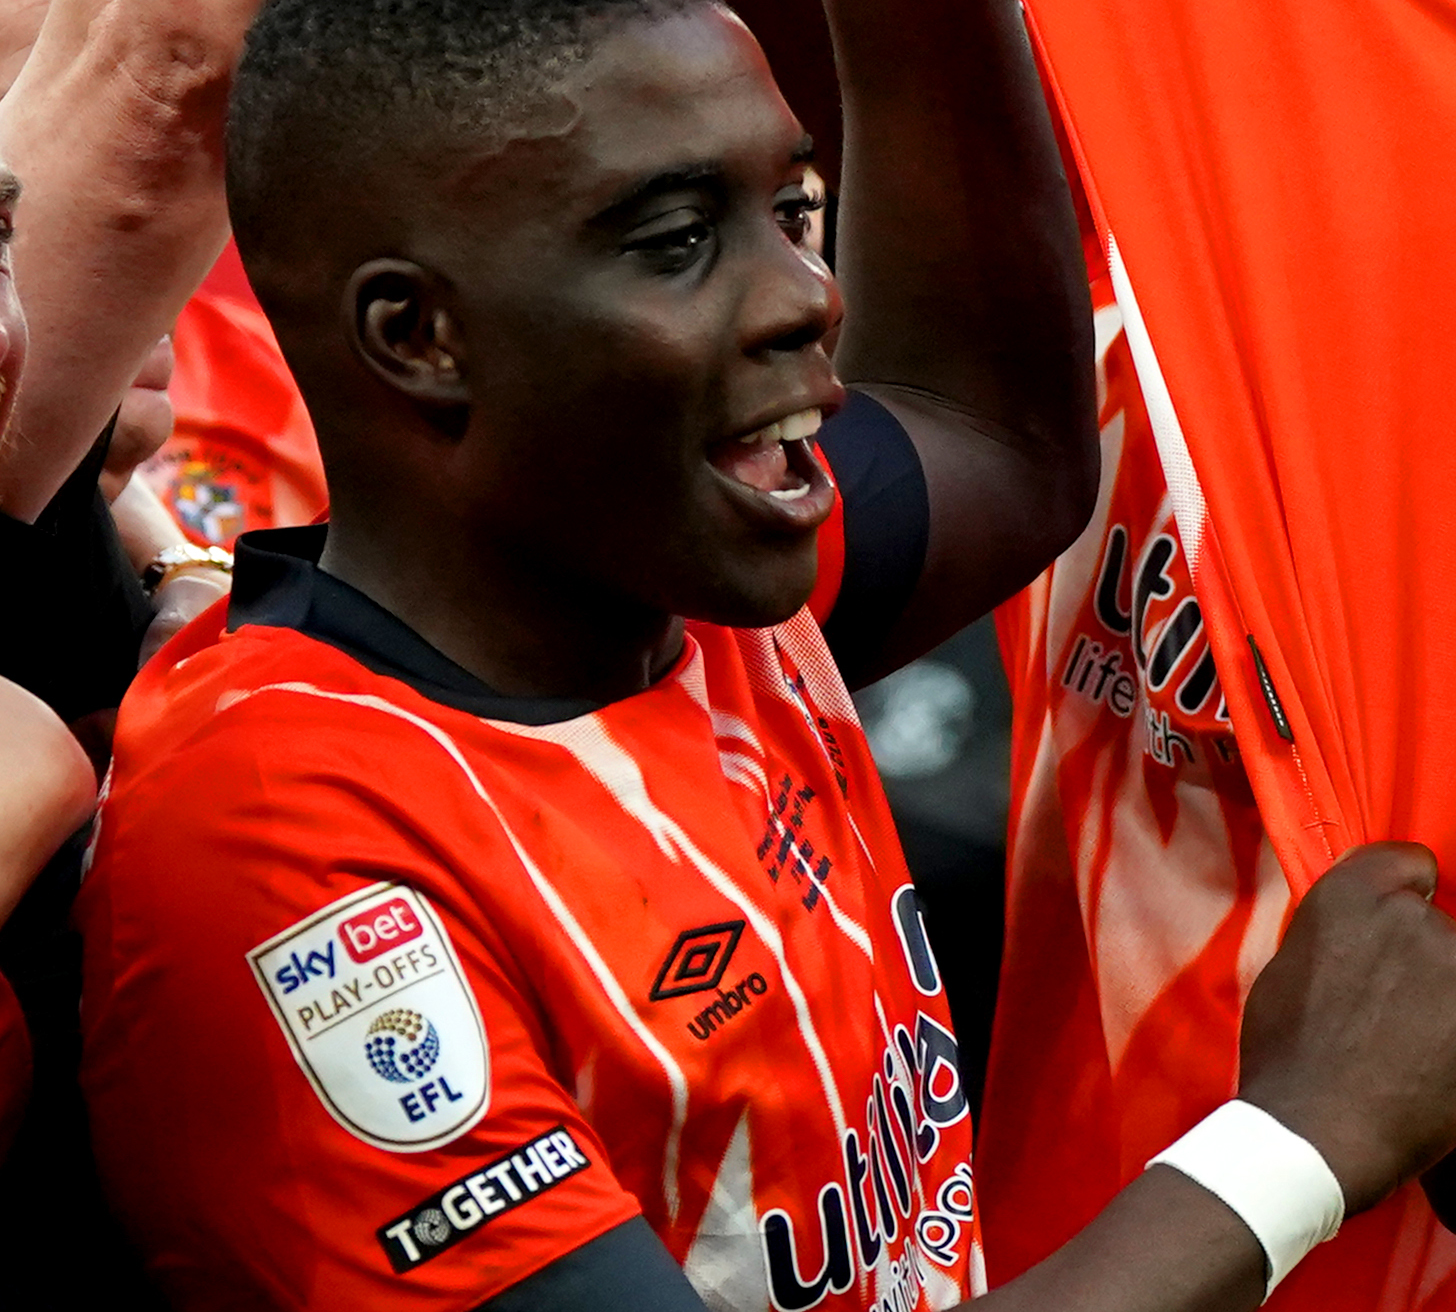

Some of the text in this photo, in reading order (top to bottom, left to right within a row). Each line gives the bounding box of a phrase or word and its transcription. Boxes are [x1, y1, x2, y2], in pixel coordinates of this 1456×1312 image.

[1062, 633, 1138, 718] life
[275, 903, 416, 996] sky bet
[295, 943, 438, 1032] PLAY-OFFS
[687, 970, 771, 1041] umbro
[397, 1076, 463, 1123] EFL
[385, 1129, 586, 1263] TOGETHER
